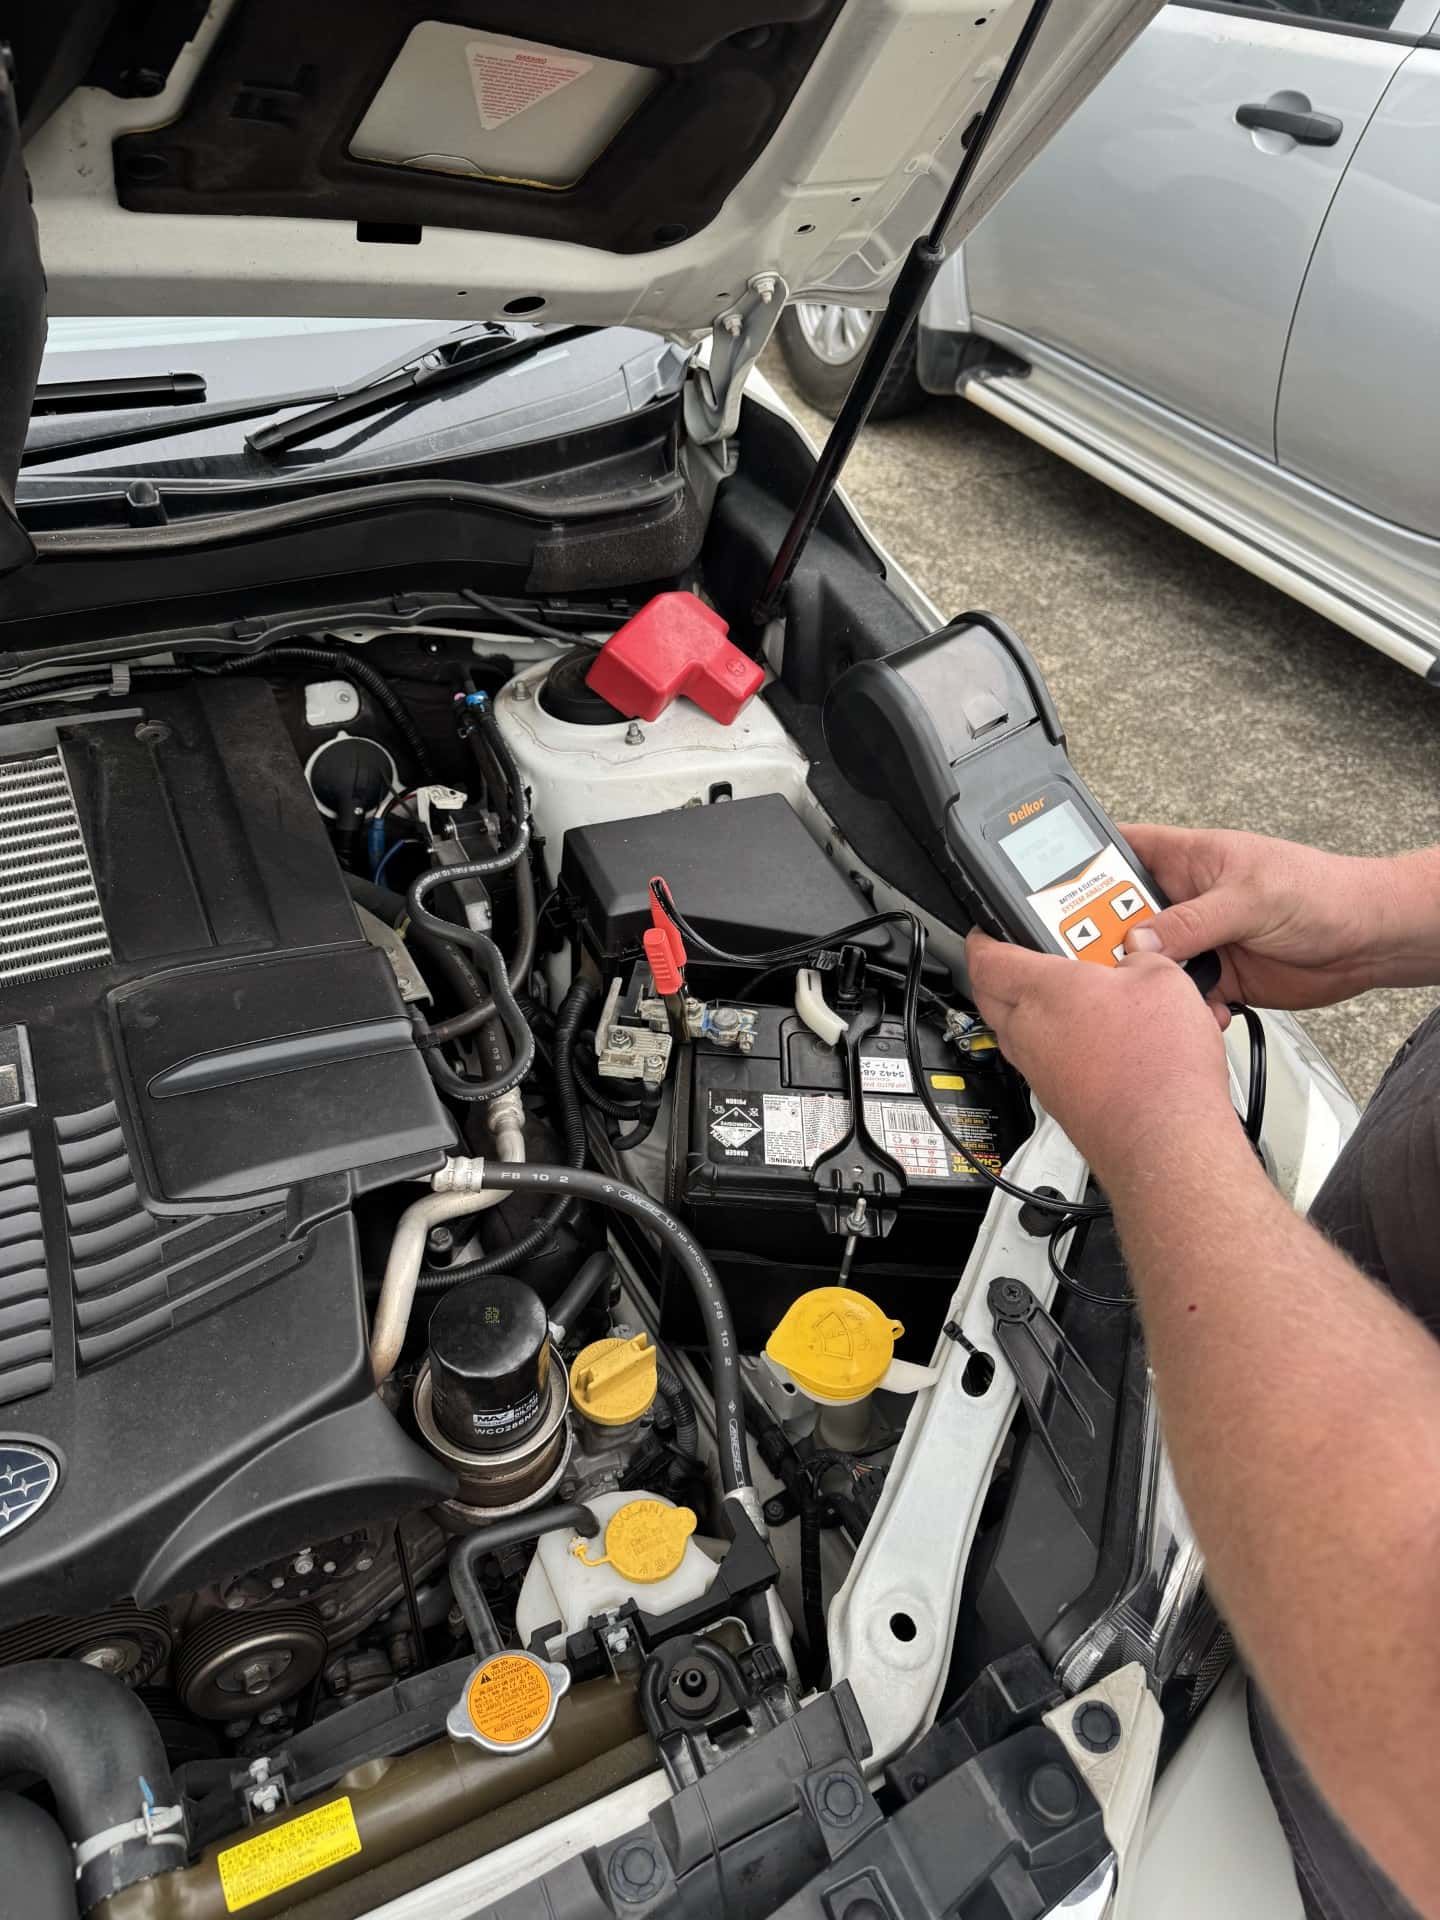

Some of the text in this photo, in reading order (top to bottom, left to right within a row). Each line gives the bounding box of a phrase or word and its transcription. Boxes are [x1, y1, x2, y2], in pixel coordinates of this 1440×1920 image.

[1008, 798, 1045, 825] Delkor
[1058, 887, 1079, 905] BATTERY
[1082, 871, 1107, 891] ELECTRICAL
[1060, 895, 1086, 914] SYSTEM
[725, 1149, 749, 1157] DANGER
[953, 1156, 1002, 1168] CHAGE
[532, 1173, 550, 1182] 10
[559, 1175, 569, 1184] 2
[720, 1330, 729, 1347] 10
[724, 1357, 732, 1366] 2
